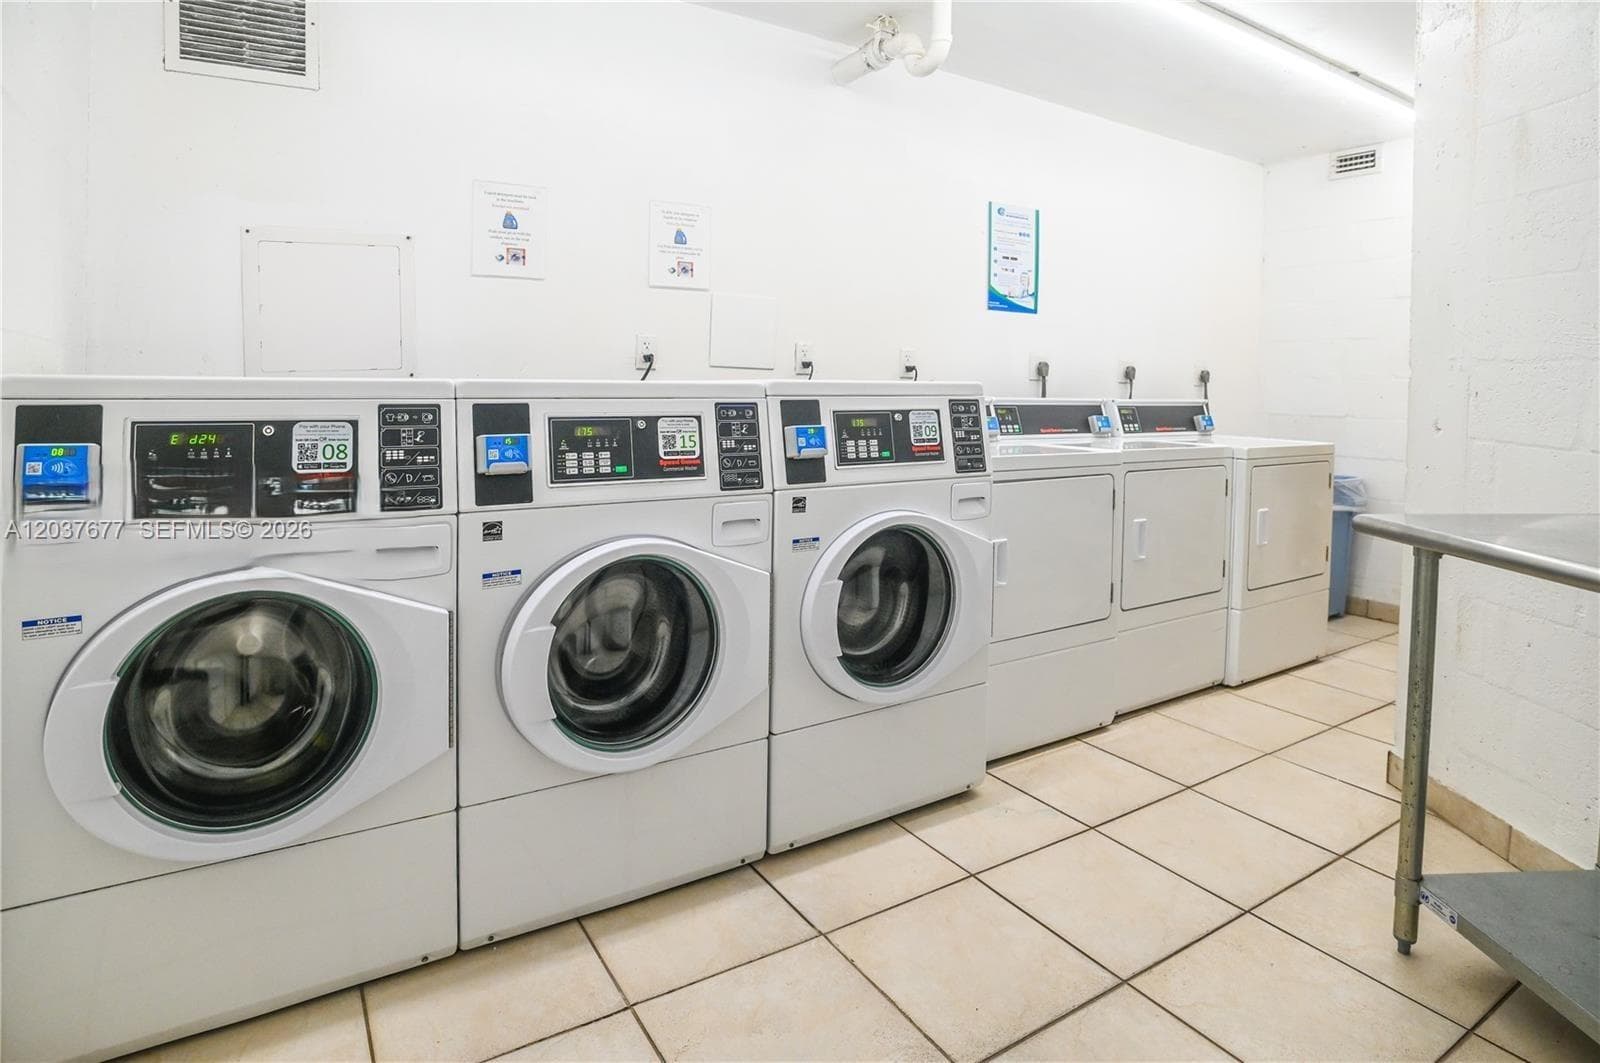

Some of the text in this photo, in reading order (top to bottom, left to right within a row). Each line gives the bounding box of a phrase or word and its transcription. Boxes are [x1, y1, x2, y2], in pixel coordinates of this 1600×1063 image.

[924, 425, 938, 437] 09
[170, 434, 179, 445] E
[680, 435, 697, 449] 15
[51, 448, 64, 457] 08
[322, 443, 348, 461] 08
[37, 617, 68, 625] NOTICE
